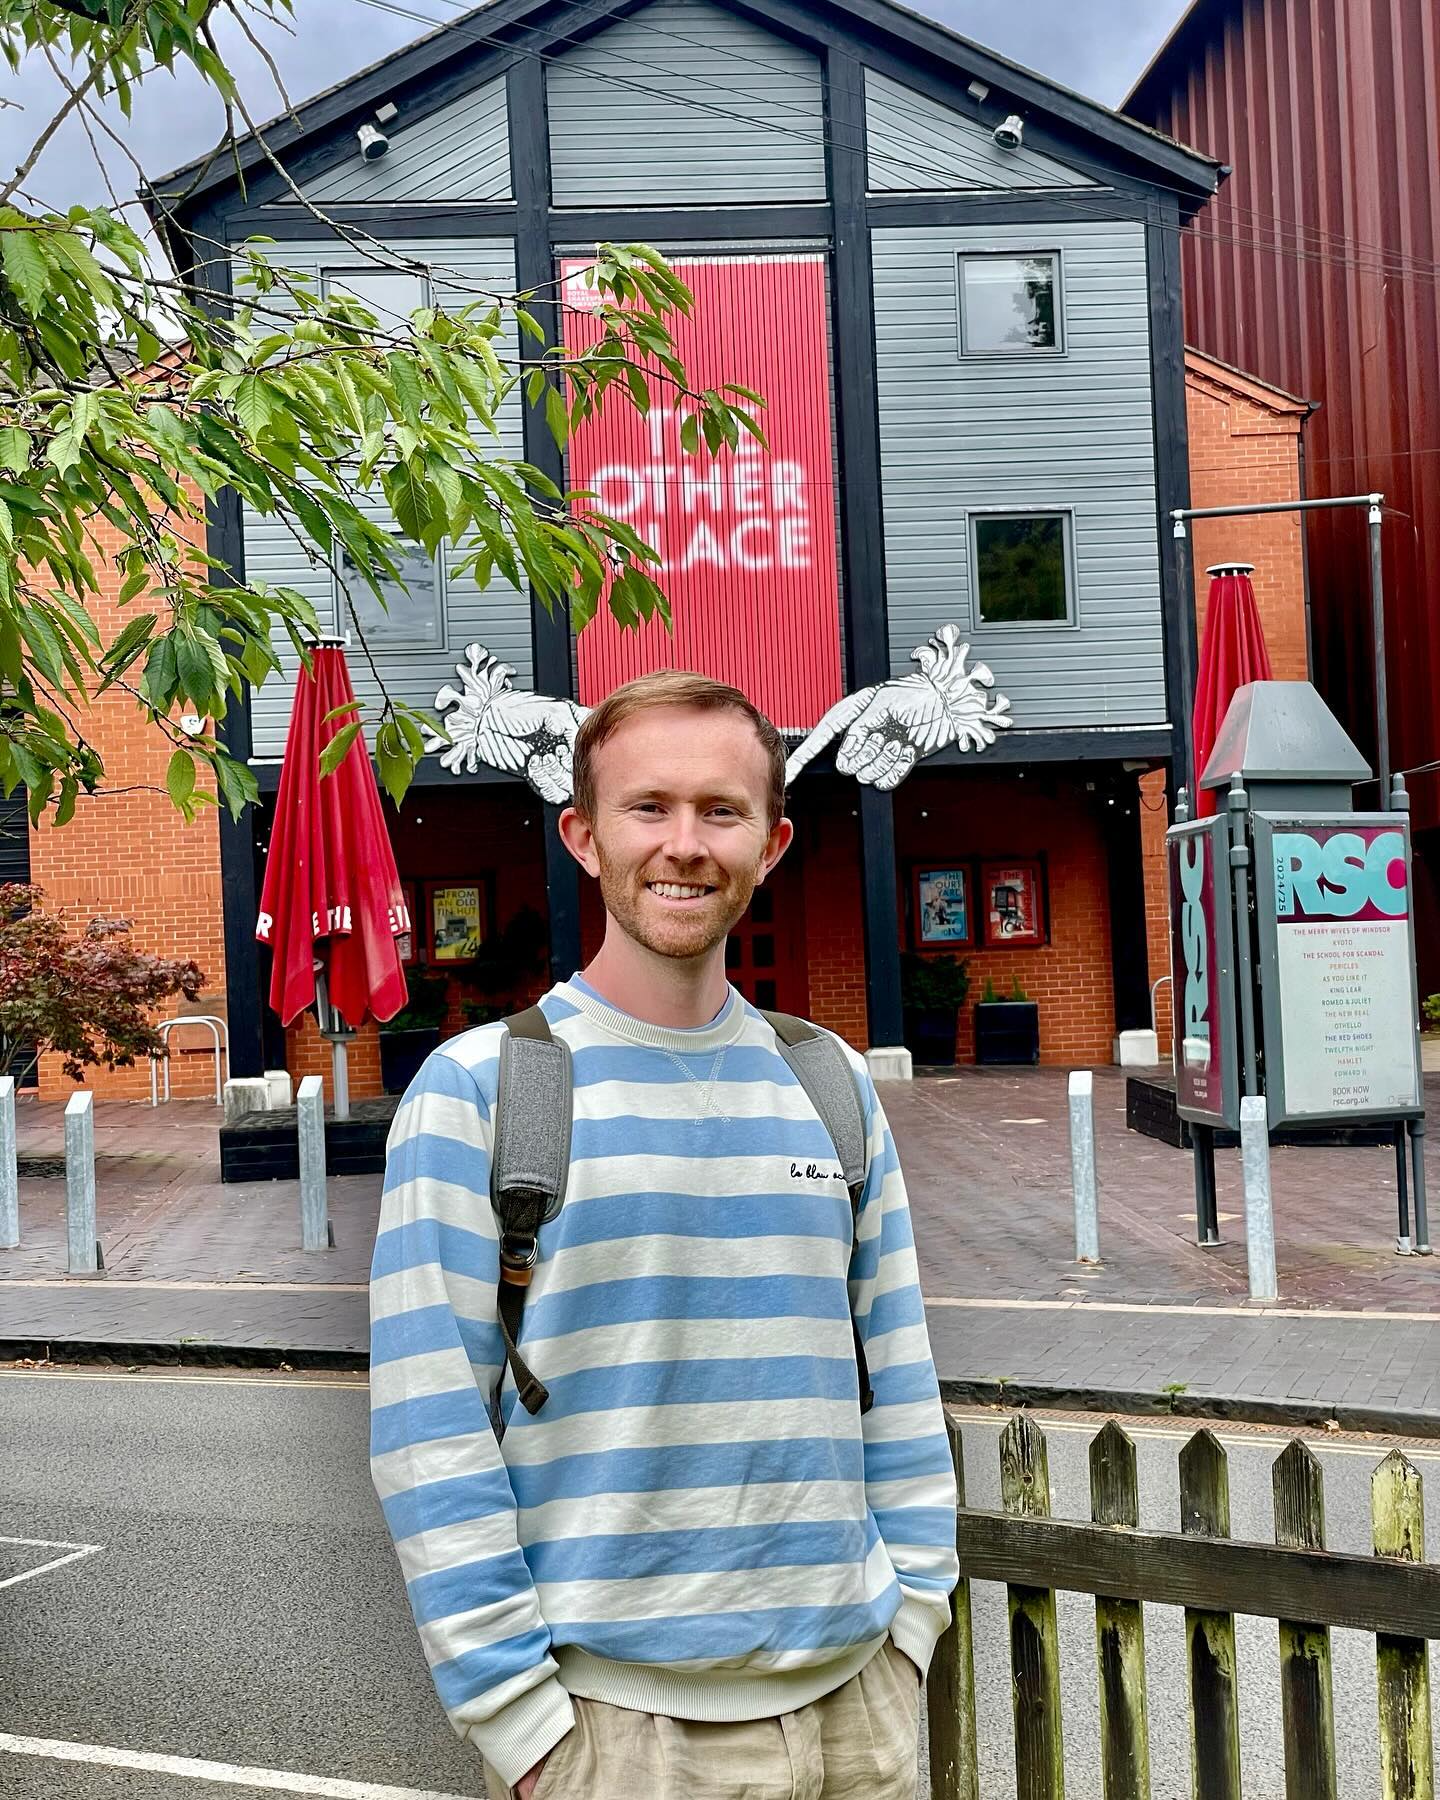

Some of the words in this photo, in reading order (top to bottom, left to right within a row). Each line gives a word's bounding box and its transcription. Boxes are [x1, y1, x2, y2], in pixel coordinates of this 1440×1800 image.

[589, 461, 809, 517] OTHER
[608, 515, 812, 573] LACE
[1272, 832, 1407, 917] RSC
[1276, 857, 1287, 912] 2024/25
[447, 890, 475, 898] FROM
[457, 907, 476, 915] HUT
[1332, 1086, 1351, 1096] BOOK
[1352, 1086, 1369, 1094] NOW
[1333, 1096, 1369, 1106] rsc.org.uk
